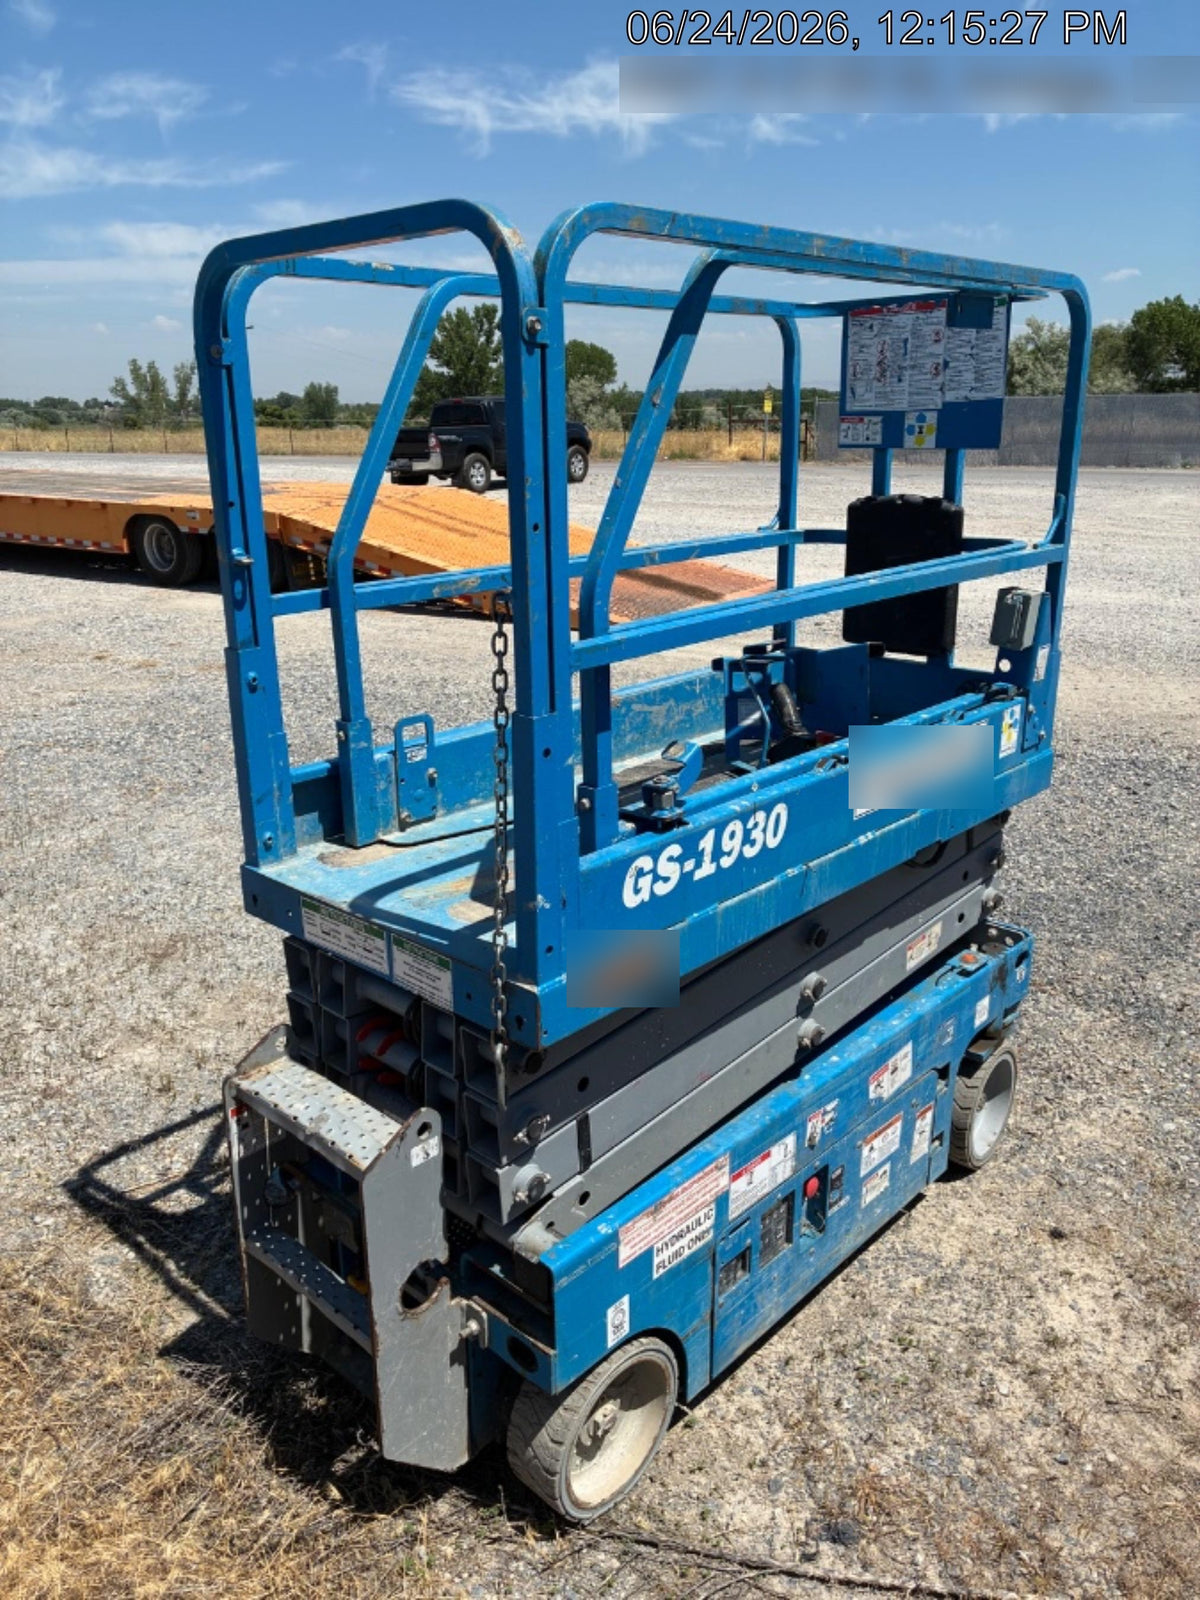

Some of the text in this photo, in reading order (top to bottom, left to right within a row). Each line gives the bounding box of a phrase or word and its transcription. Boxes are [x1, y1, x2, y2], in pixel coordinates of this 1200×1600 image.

[622, 802, 789, 909] GS-1930
[655, 1207, 714, 1258] HYDRAULIC
[655, 1243, 686, 1276] FLUID
